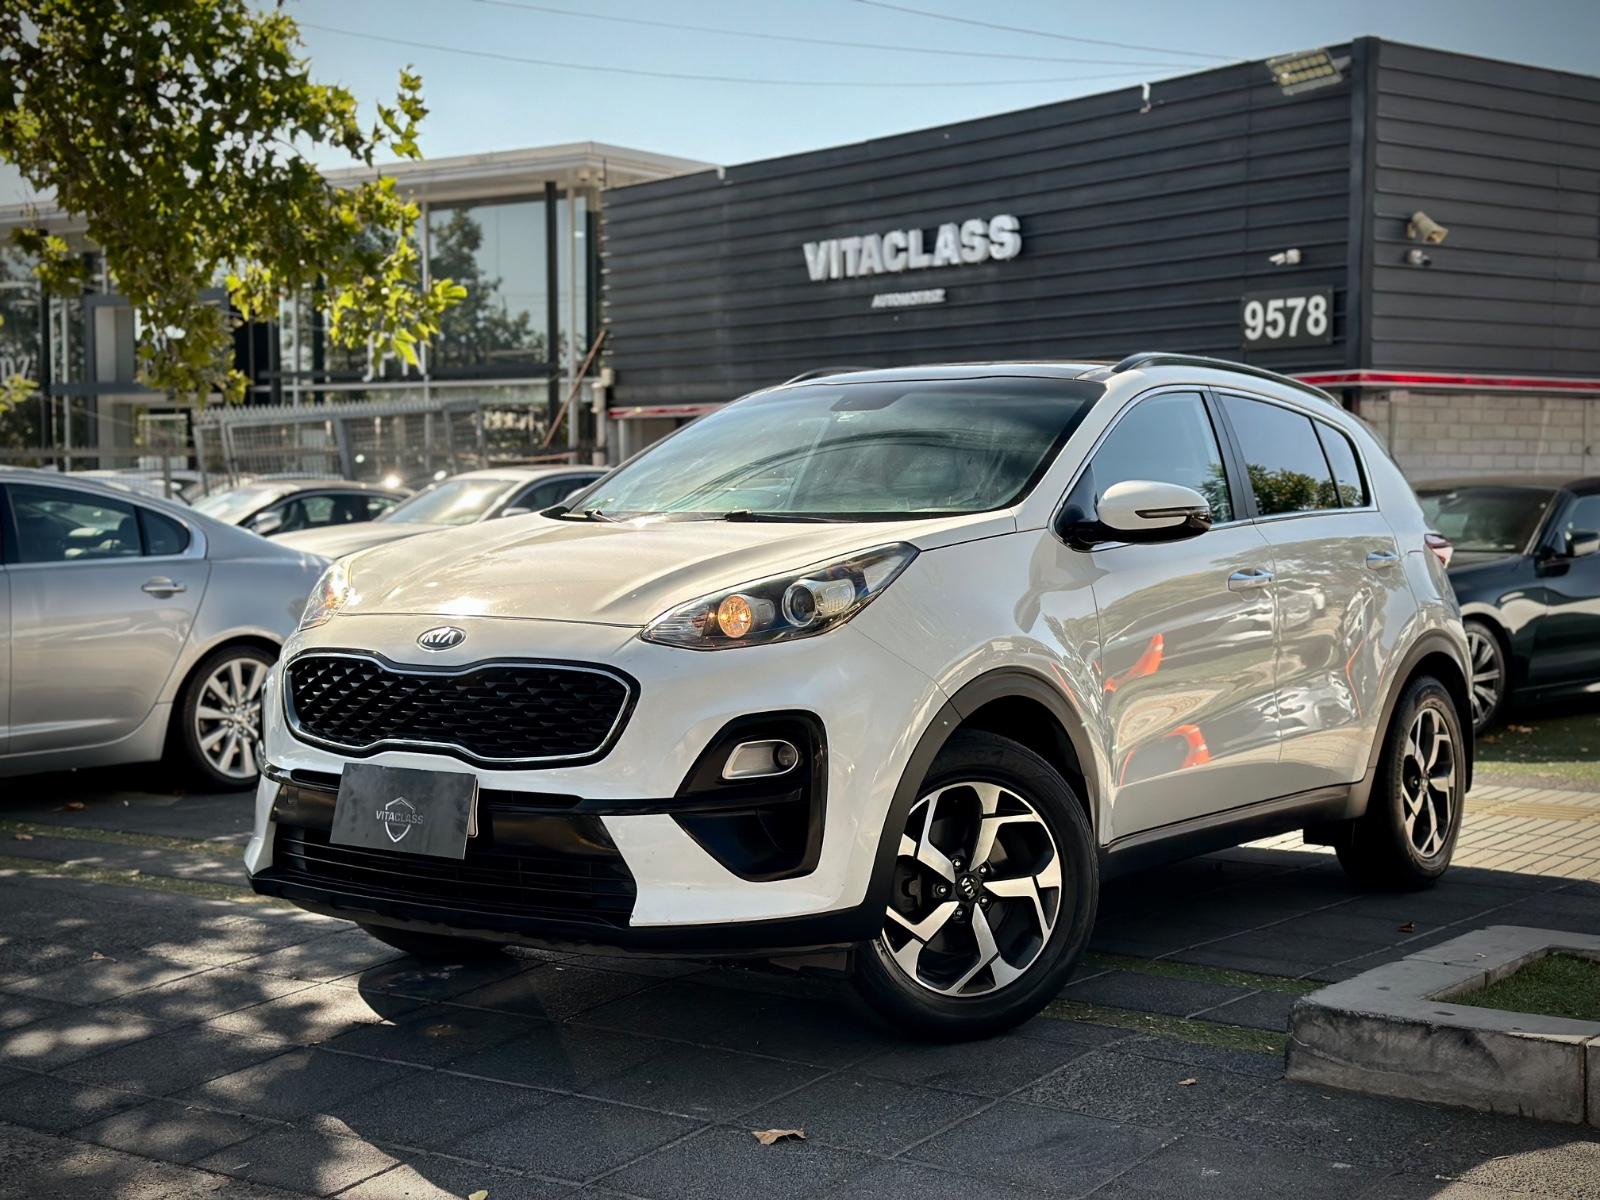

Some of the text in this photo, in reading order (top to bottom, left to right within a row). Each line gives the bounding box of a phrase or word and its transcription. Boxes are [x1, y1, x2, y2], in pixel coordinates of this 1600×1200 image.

[803, 214, 1022, 281] VITACLASS
[1244, 294, 1328, 341] 9578
[376, 810, 424, 824] VITACLASS
